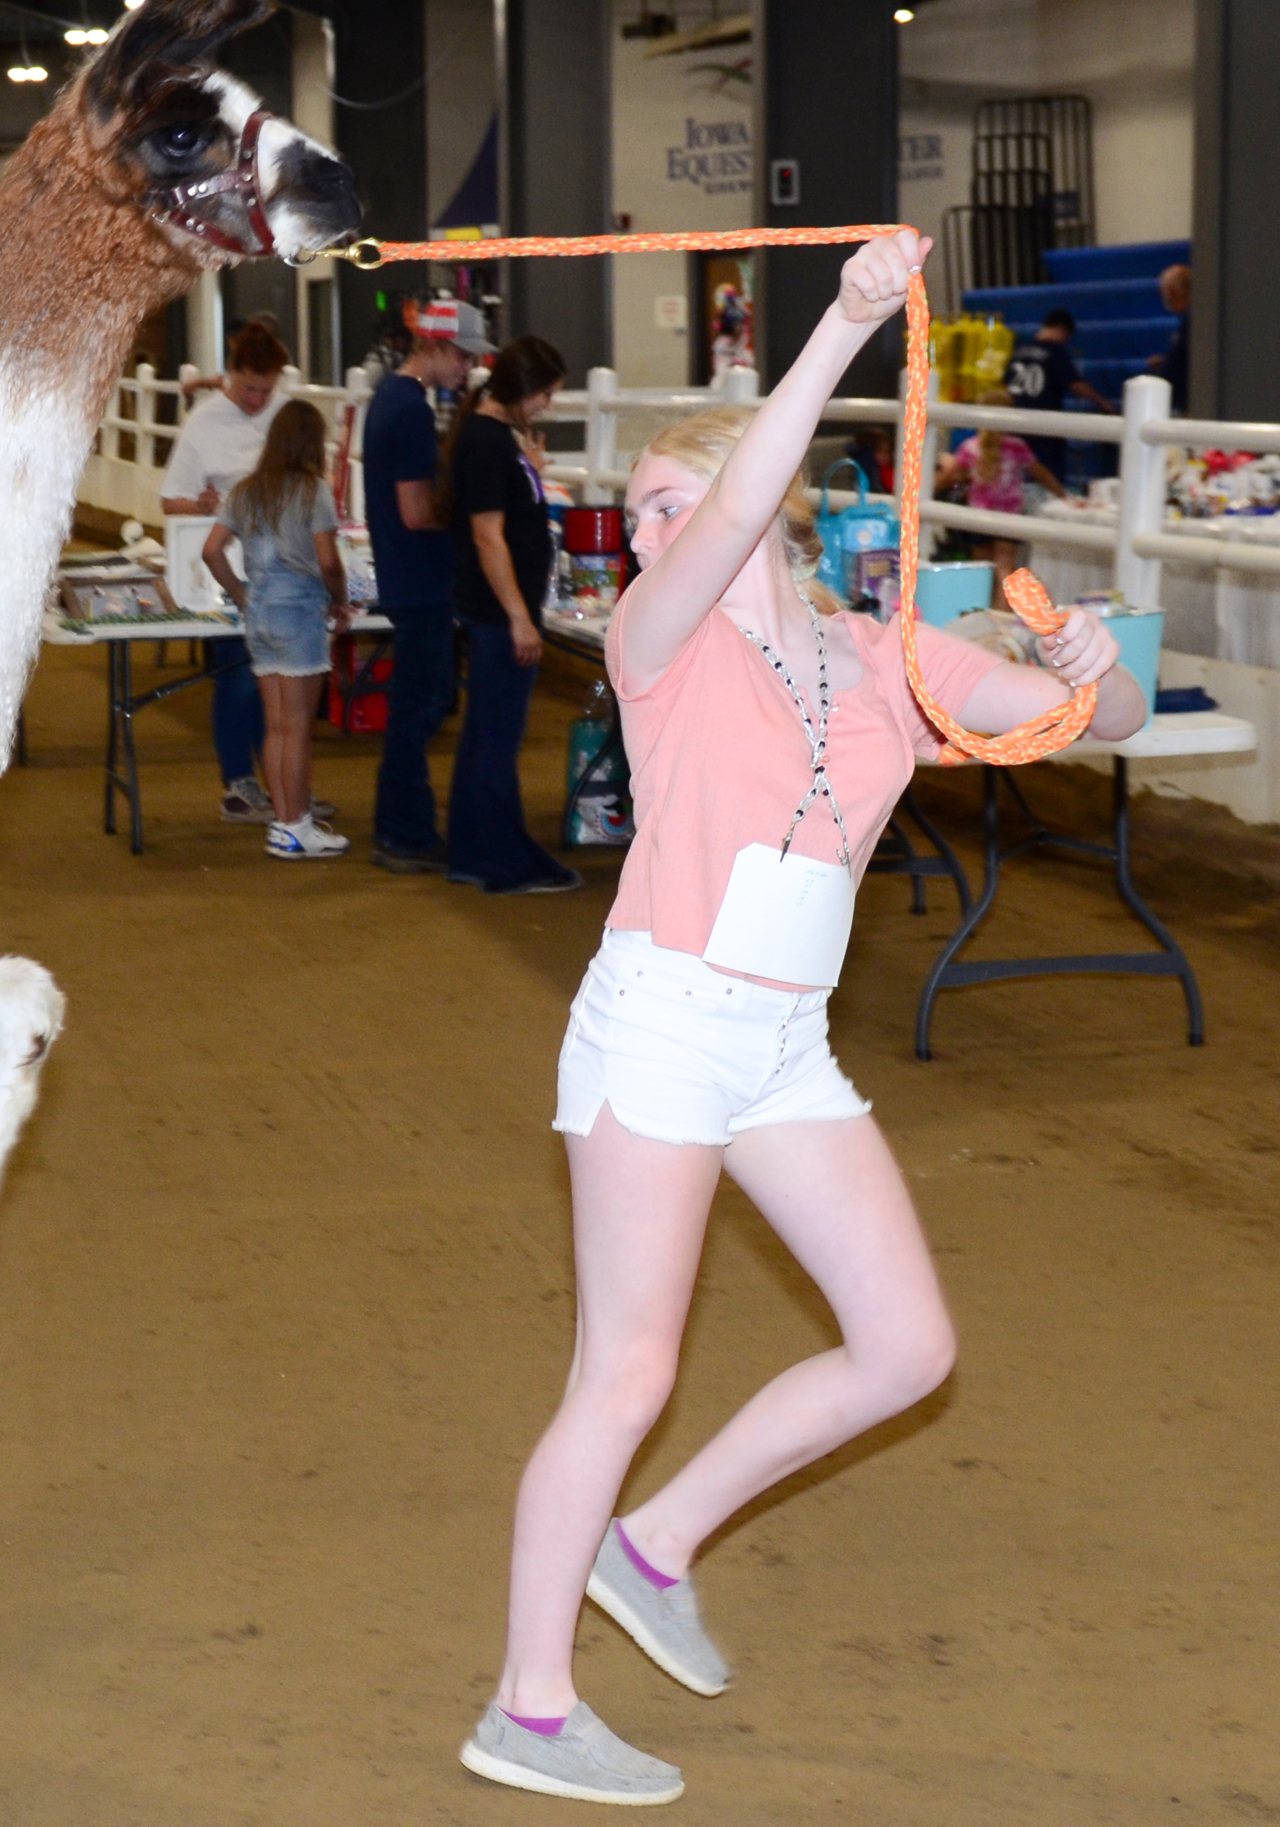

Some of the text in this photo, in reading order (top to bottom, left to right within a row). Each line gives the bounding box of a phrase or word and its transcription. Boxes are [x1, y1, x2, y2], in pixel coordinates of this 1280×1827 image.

[686, 118, 749, 148] IOWA
[667, 148, 753, 185] EQUES
[1008, 362, 1045, 397] 20
